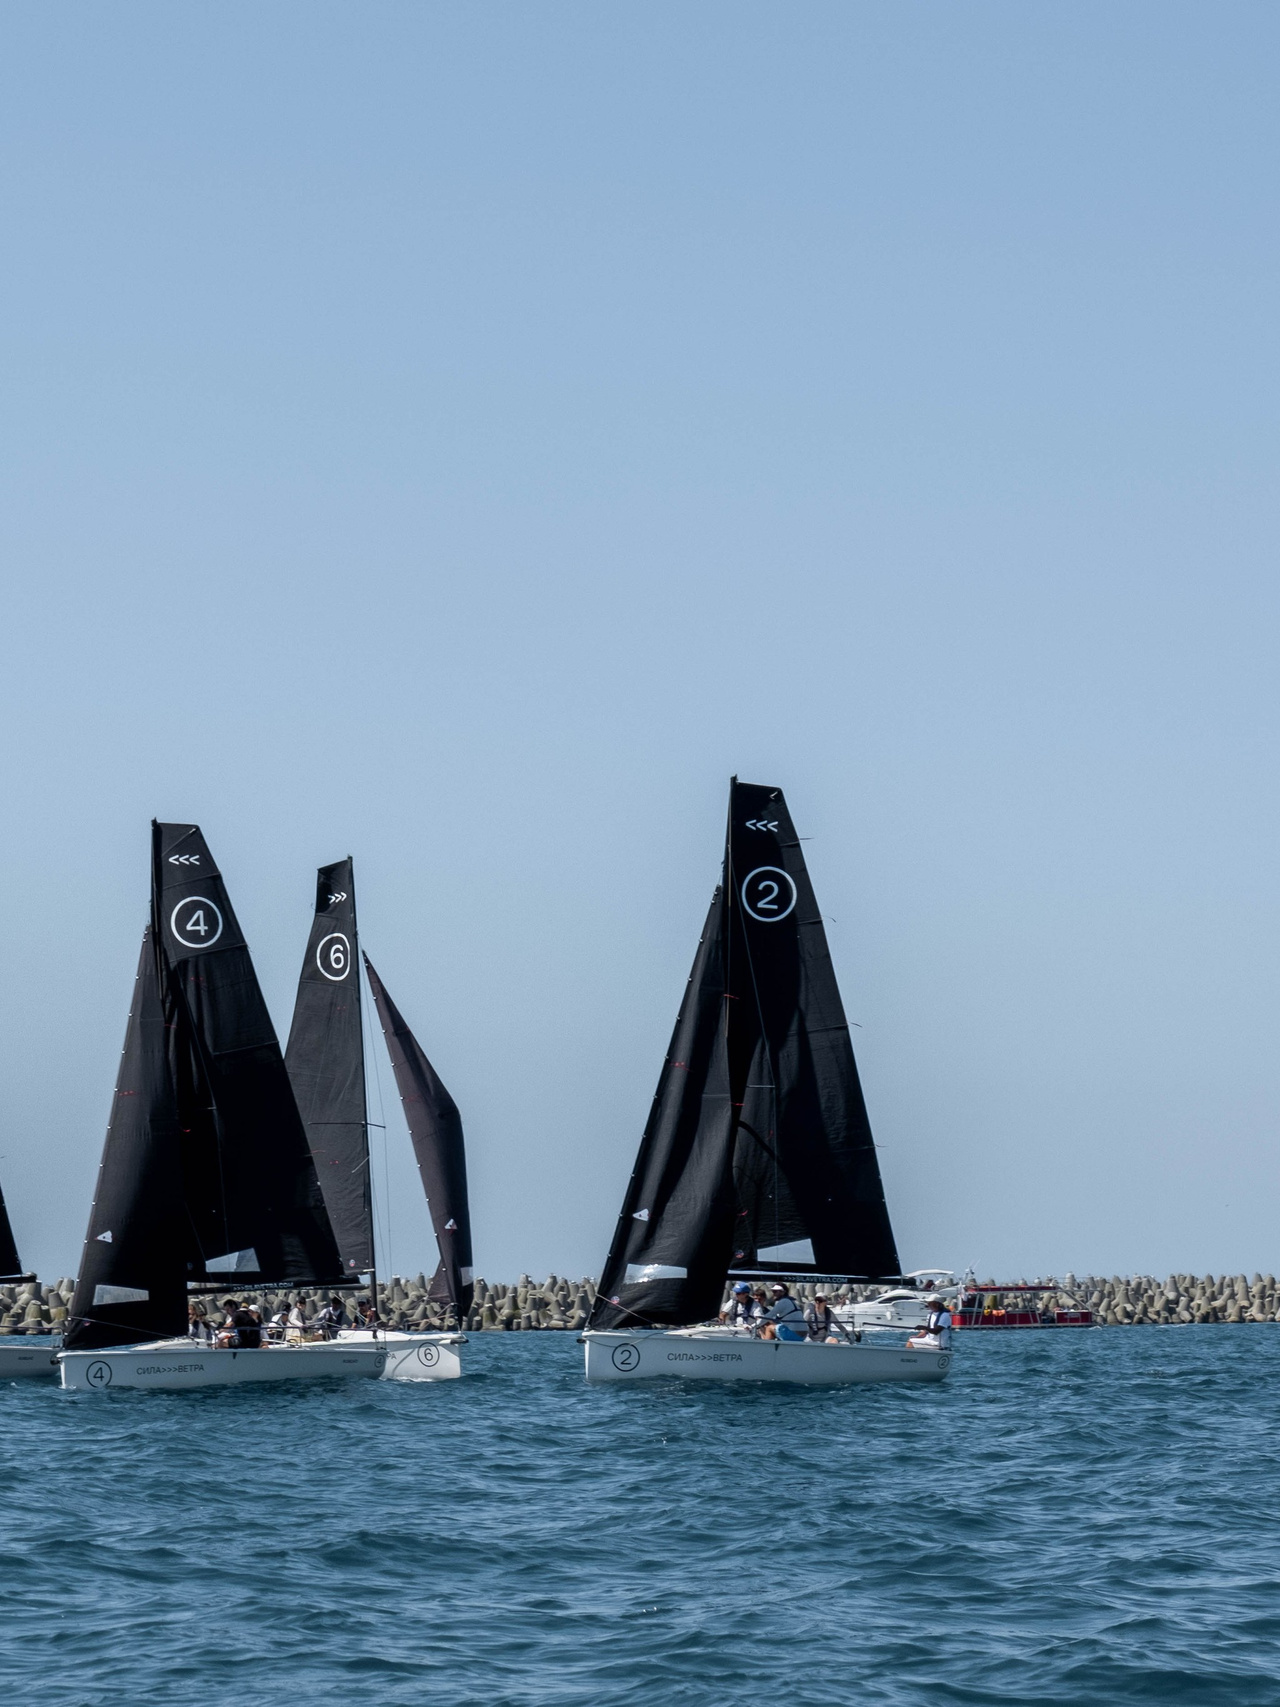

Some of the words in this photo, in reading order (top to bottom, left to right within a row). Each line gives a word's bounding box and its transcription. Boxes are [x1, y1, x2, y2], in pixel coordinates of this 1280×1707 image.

[757, 880, 779, 909] 2
[185, 910, 208, 935] 4
[330, 944, 344, 968] 6
[423, 1347, 433, 1361] 6
[620, 1349, 632, 1366] 2
[92, 1366, 105, 1382] 4
